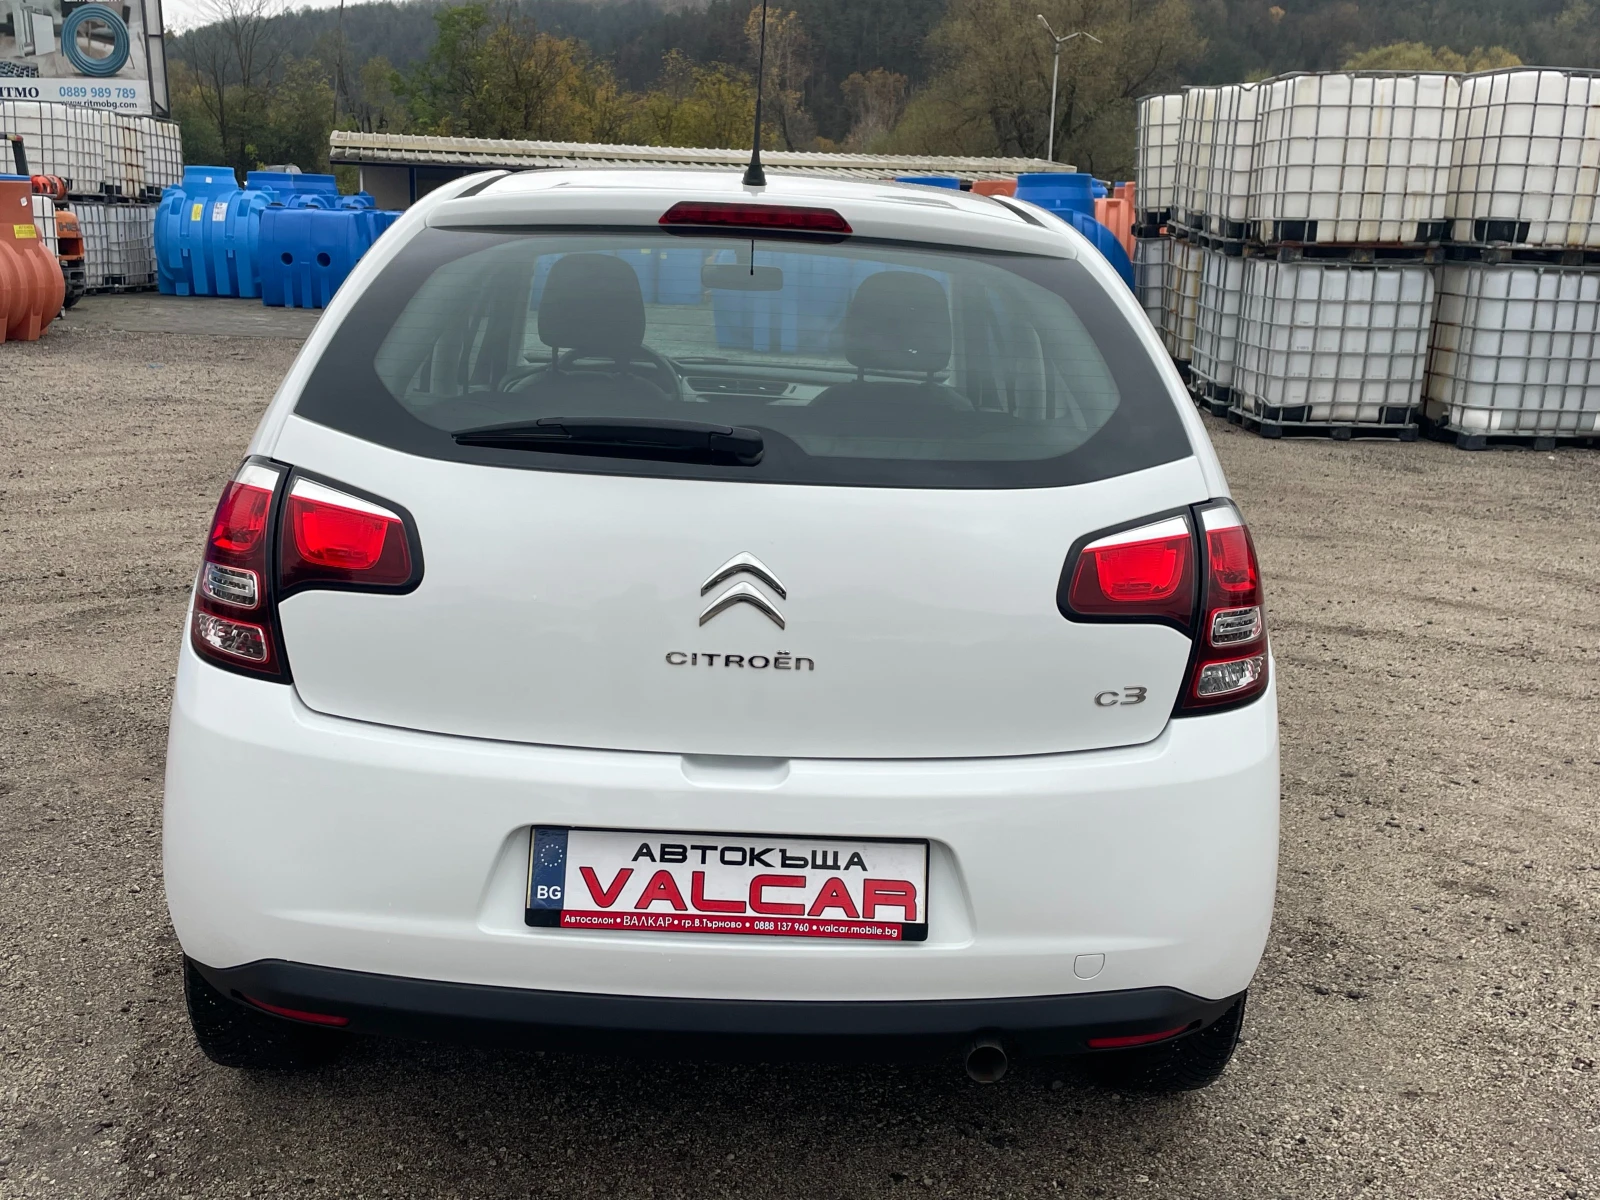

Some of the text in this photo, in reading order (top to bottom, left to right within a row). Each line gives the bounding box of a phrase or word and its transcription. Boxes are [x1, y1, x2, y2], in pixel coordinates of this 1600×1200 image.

[59, 86, 136, 99] 0889 989 789
[1094, 686, 1148, 707] C3
[632, 842, 868, 872] АВТОКЪЩА
[537, 885, 562, 900] BG
[579, 866, 917, 921] VALCAR
[564, 914, 898, 937] Автосалон ВАЛКАР гр.В.Търново 0888 137 960 valcar.mobile.bg
